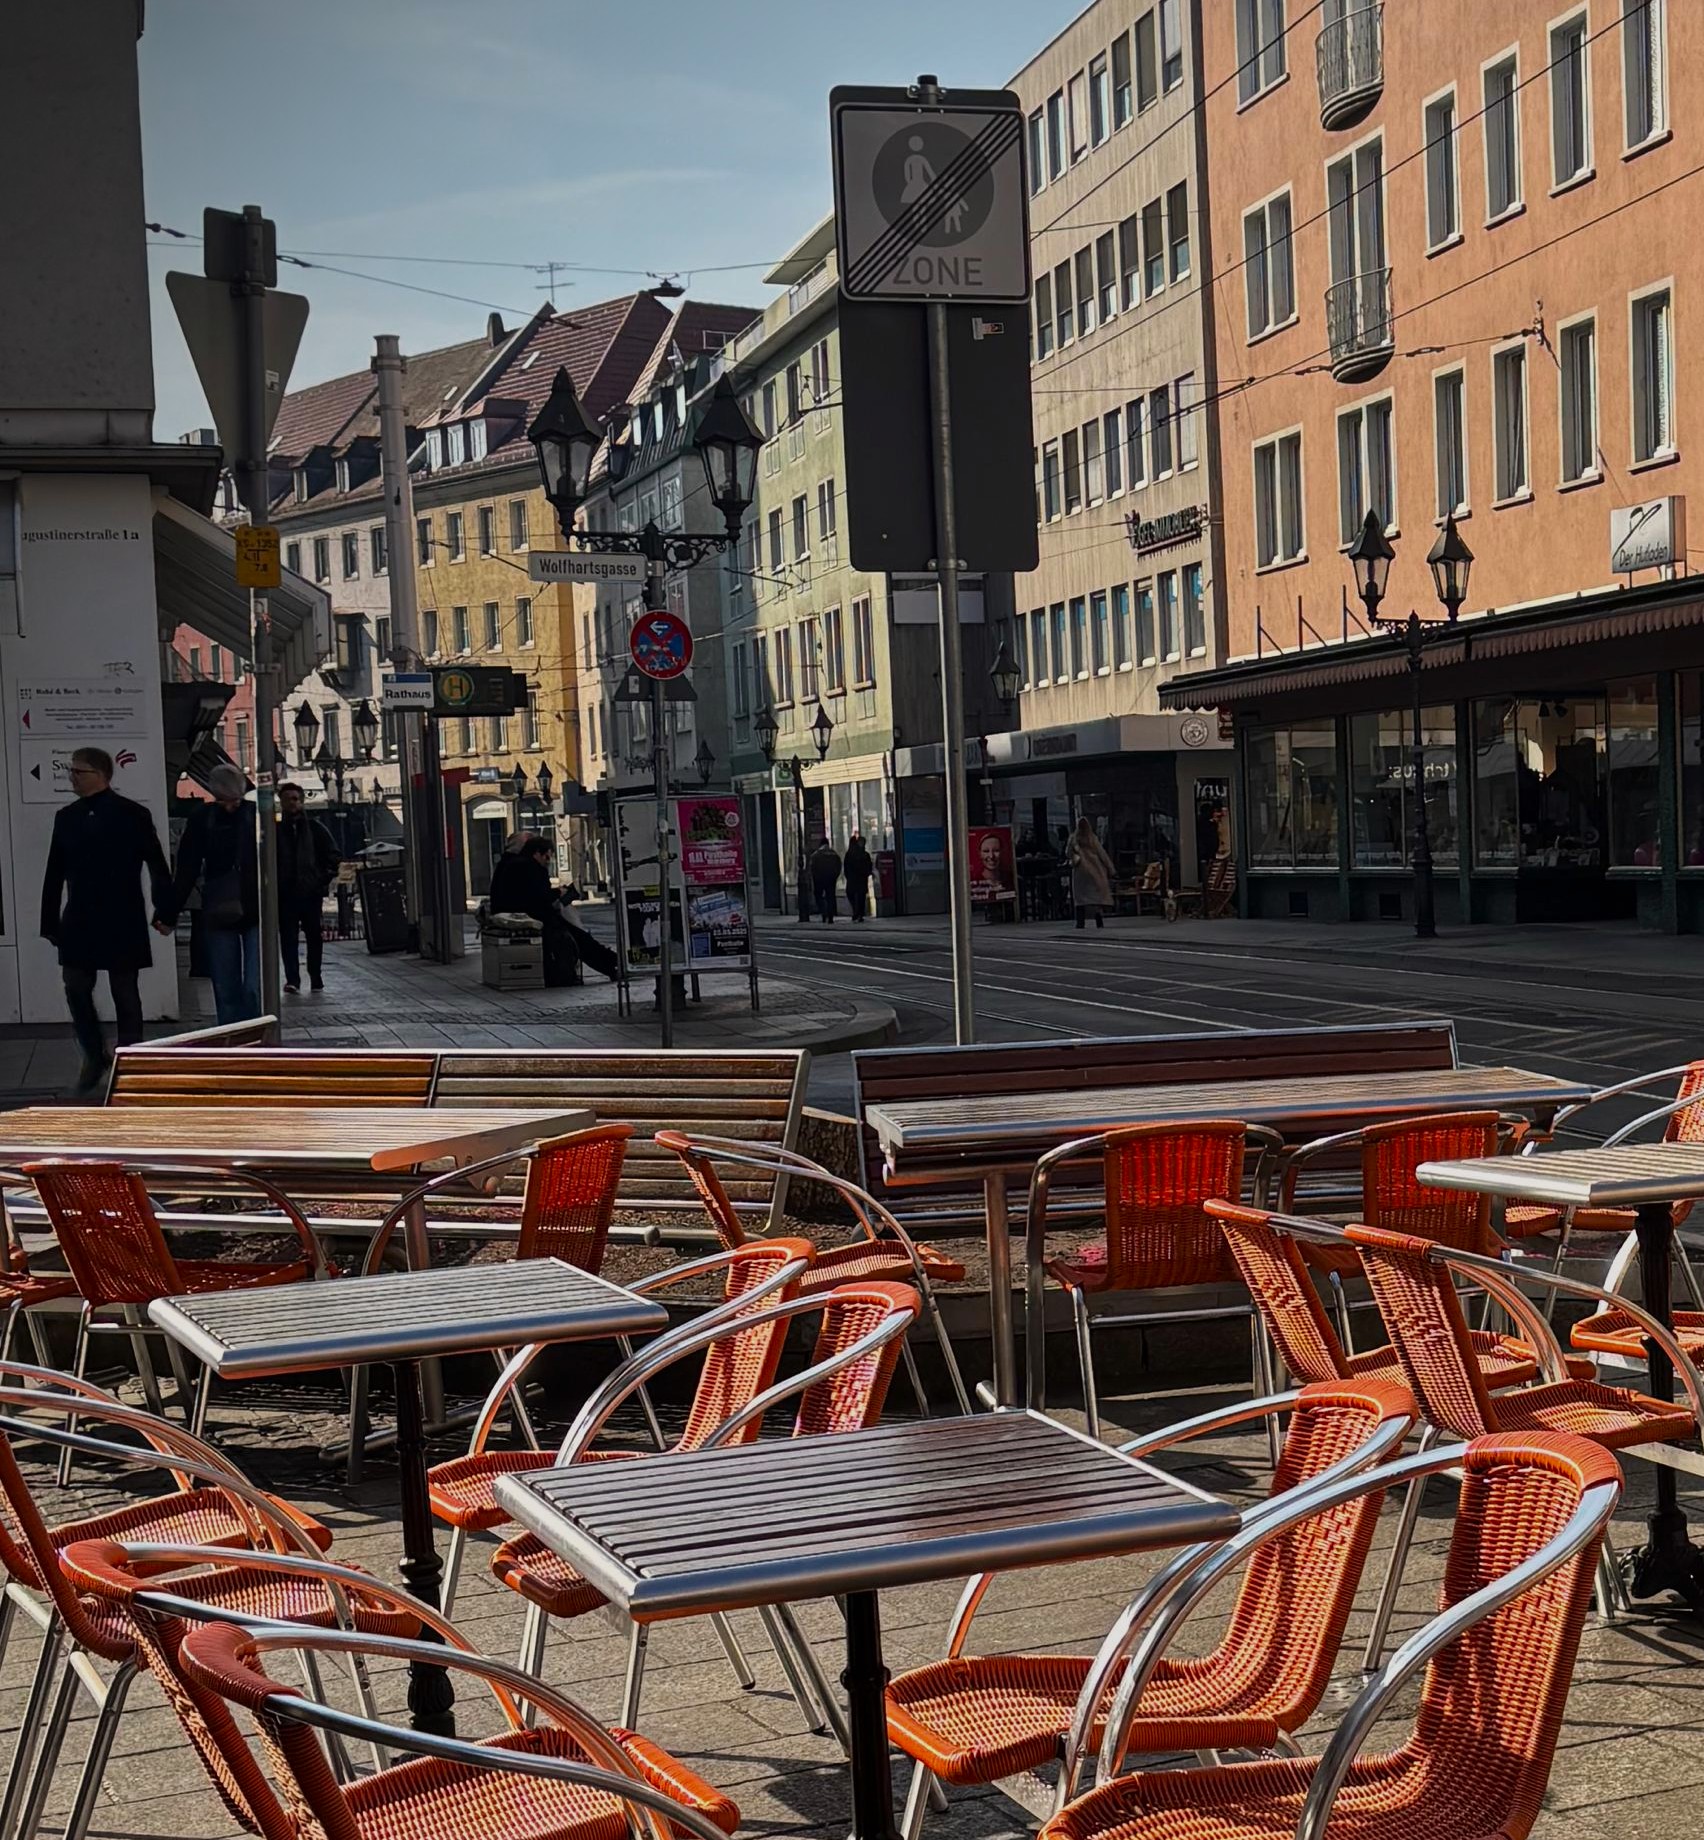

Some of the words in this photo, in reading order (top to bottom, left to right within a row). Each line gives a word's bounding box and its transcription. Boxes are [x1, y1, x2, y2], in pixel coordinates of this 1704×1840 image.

[893, 256, 983, 286] ZONE
[21, 529, 120, 542] ugustinerstraße
[1620, 549, 1634, 567] Der
[1635, 541, 1668, 565] Hutladen
[539, 558, 637, 579] Wolfhartsgasse
[385, 689, 431, 699] Rathaus
[449, 677, 463, 697] H
